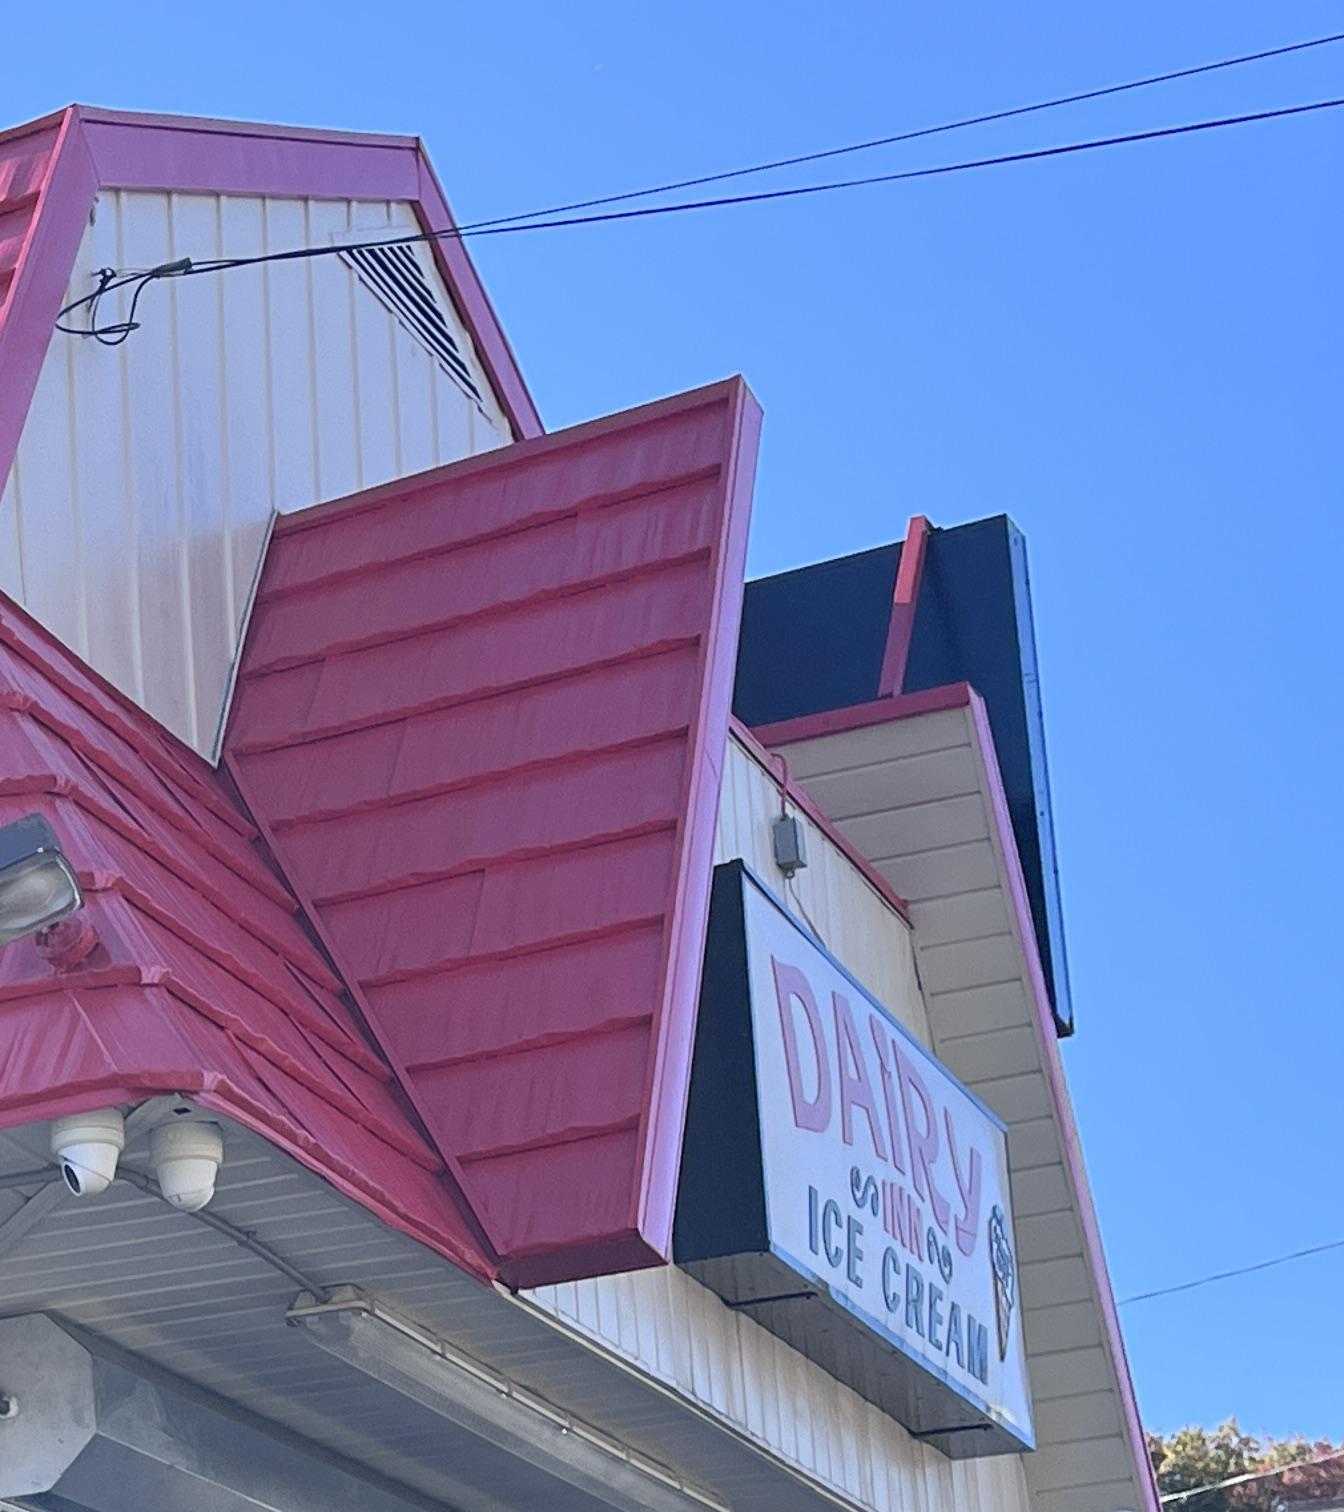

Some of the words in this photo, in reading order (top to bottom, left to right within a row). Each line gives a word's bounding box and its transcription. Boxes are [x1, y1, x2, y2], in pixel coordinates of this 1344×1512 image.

[807, 1183, 864, 1290] ICE
[881, 1246, 989, 1387] CREAM
[882, 1181, 924, 1263] INN
